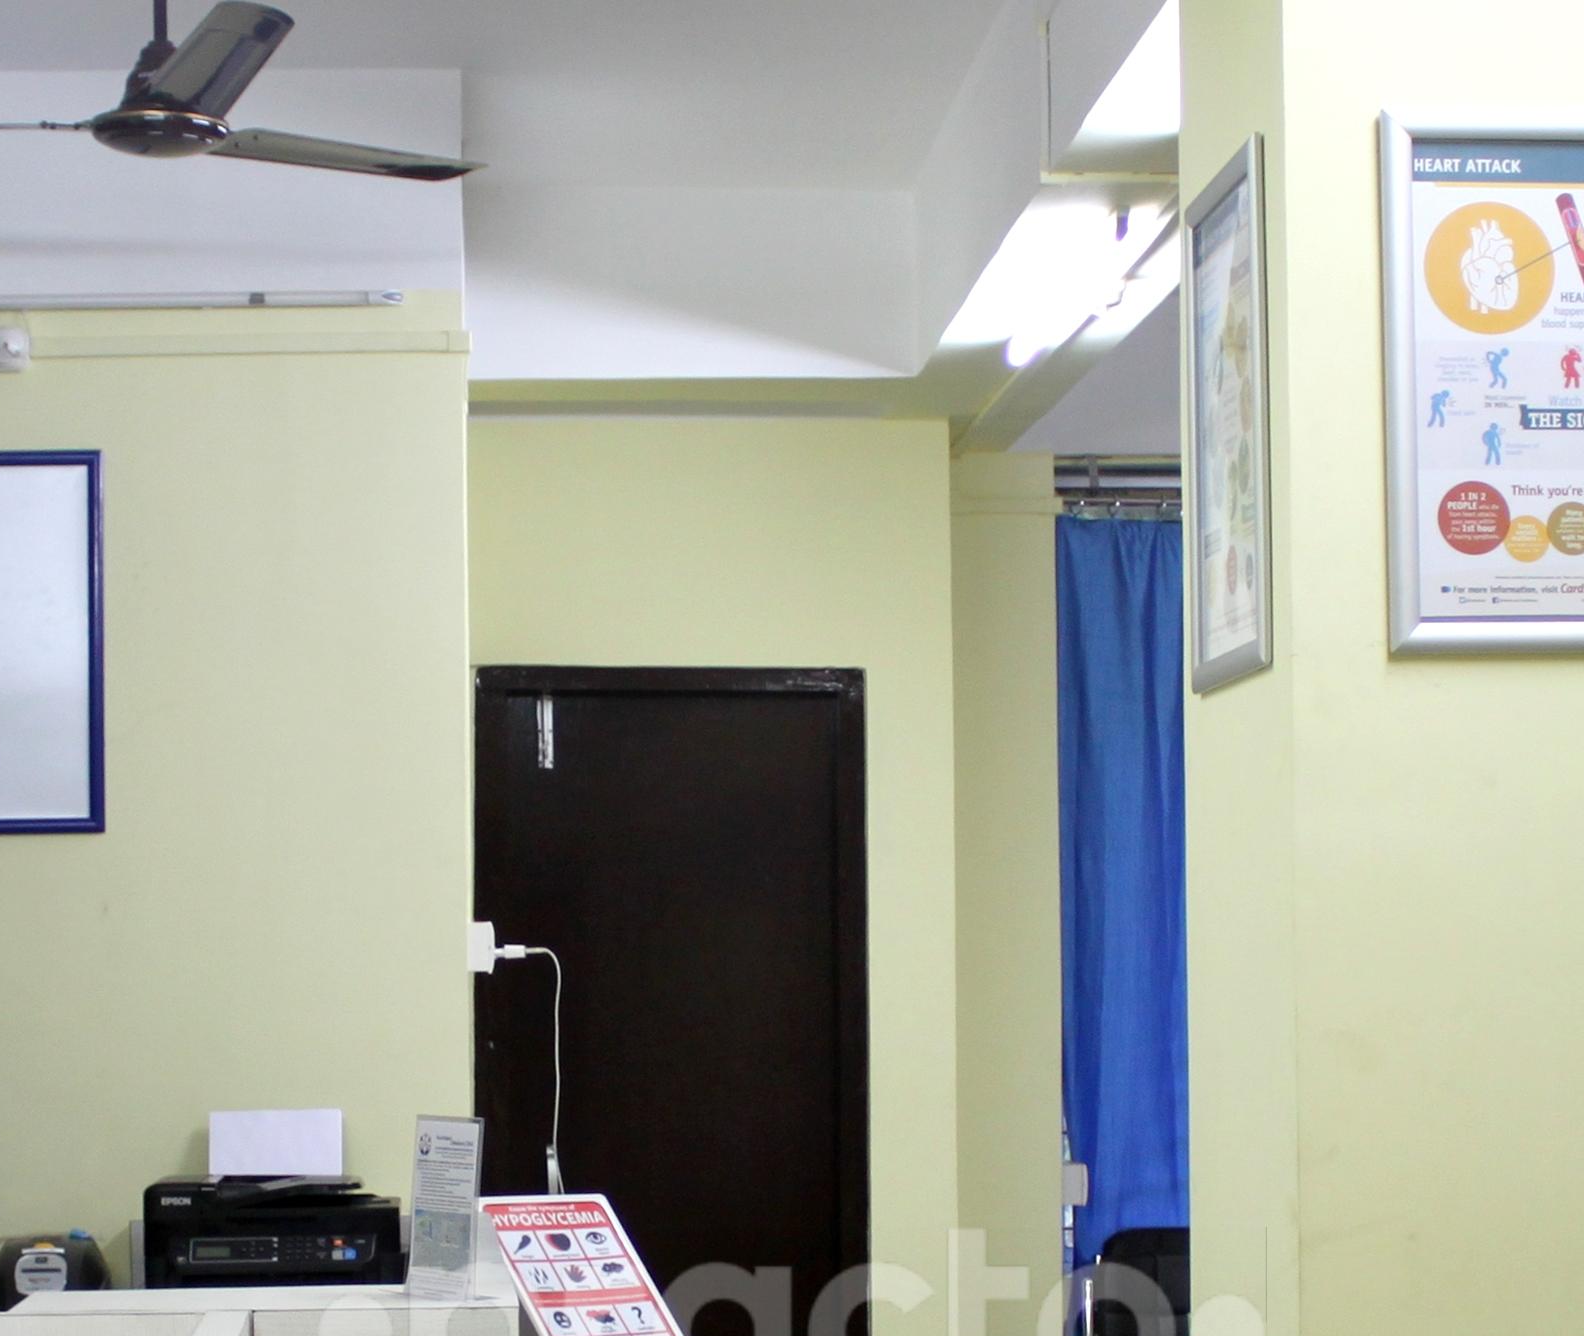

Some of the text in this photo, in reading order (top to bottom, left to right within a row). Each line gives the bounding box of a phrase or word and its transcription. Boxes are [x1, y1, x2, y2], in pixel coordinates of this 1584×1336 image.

[1414, 158, 1521, 174] HEART ATTACK
[1541, 318, 1567, 328] blood
[1528, 412, 1562, 428] THE
[1468, 492, 1479, 501] IN
[1512, 485, 1544, 496] Think
[1547, 485, 1583, 499] you're
[1447, 501, 1478, 510] PEOPLE
[160, 1196, 192, 1206] EPSON
[492, 1210, 606, 1227] HYPOGLYCEMIA
